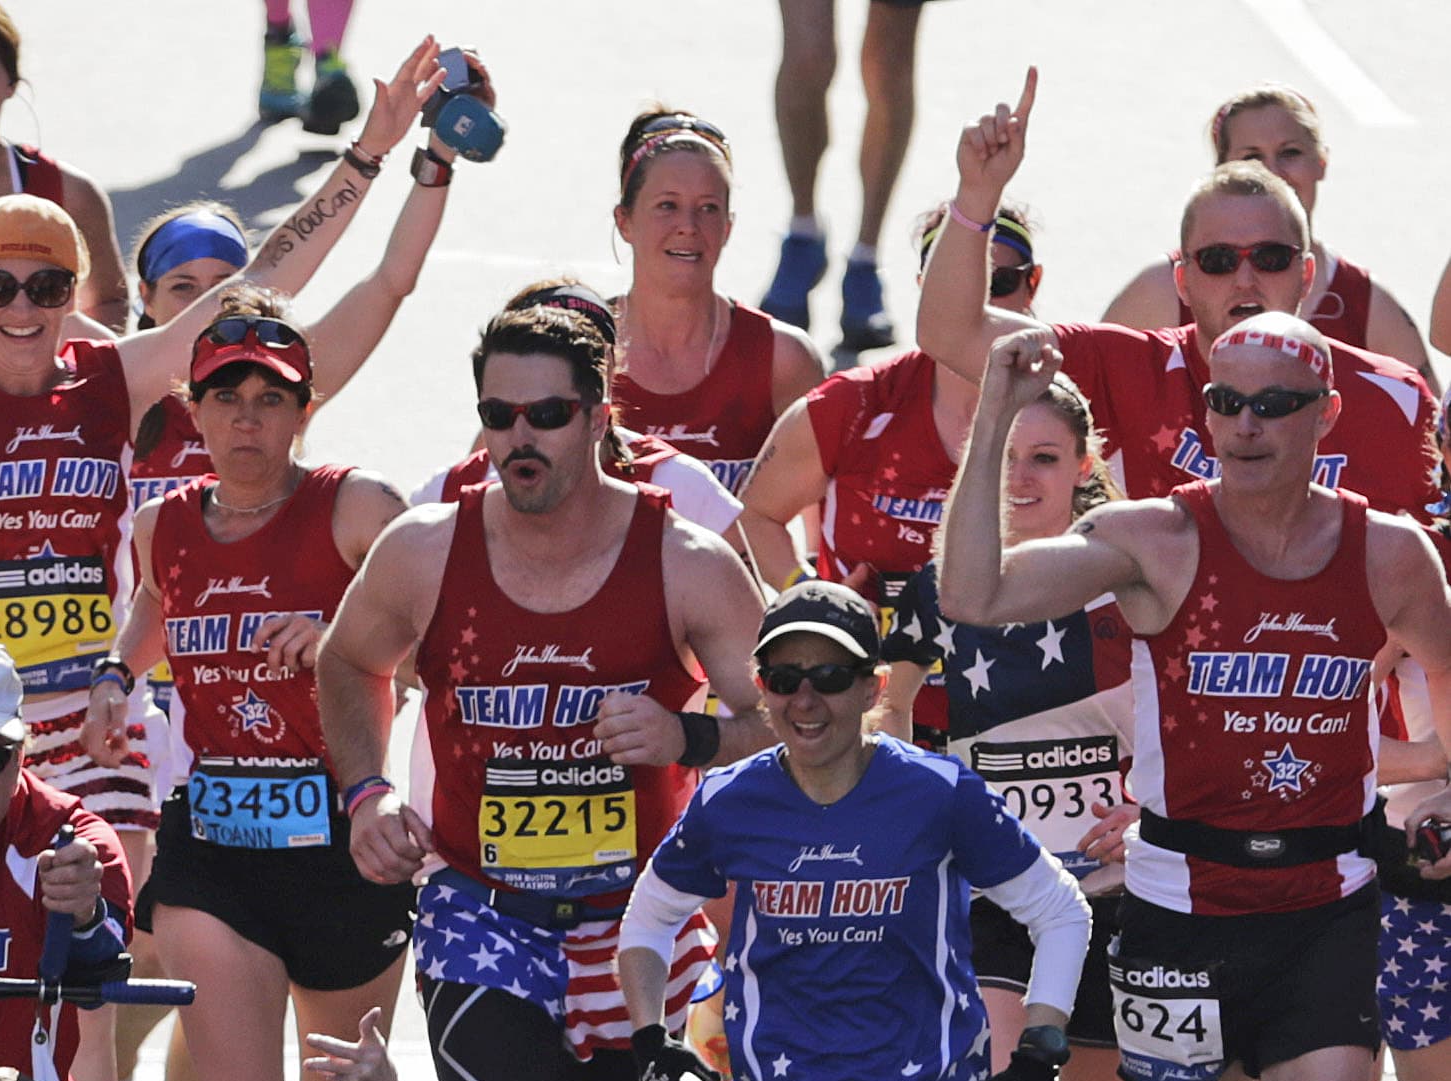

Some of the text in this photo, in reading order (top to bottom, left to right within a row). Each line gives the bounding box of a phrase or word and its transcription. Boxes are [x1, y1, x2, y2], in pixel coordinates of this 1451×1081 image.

[50, 456, 120, 501] HOYT
[26, 509, 59, 530] You
[59, 508, 102, 529] Can!
[27, 562, 104, 587] adidas
[164, 613, 231, 658] TEAM
[1243, 611, 1340, 644] John Hancock
[192, 664, 221, 686] Yes
[501, 644, 597, 678] John Hancock
[1186, 652, 1290, 698] TEAM
[454, 683, 549, 730] TEAM
[1222, 710, 1351, 735] Yes You Can!
[491, 740, 524, 760] Yes
[529, 741, 567, 761] You
[1026, 743, 1112, 769] adidas
[540, 764, 626, 787] adidas
[193, 775, 322, 820] 23450
[484, 795, 627, 838] 32215
[484, 842, 498, 864] 6
[752, 876, 911, 919] TEAM HOYT
[777, 925, 885, 946] Yes You Can!
[1125, 965, 1211, 989] adidas
[1120, 996, 1208, 1043] 624
